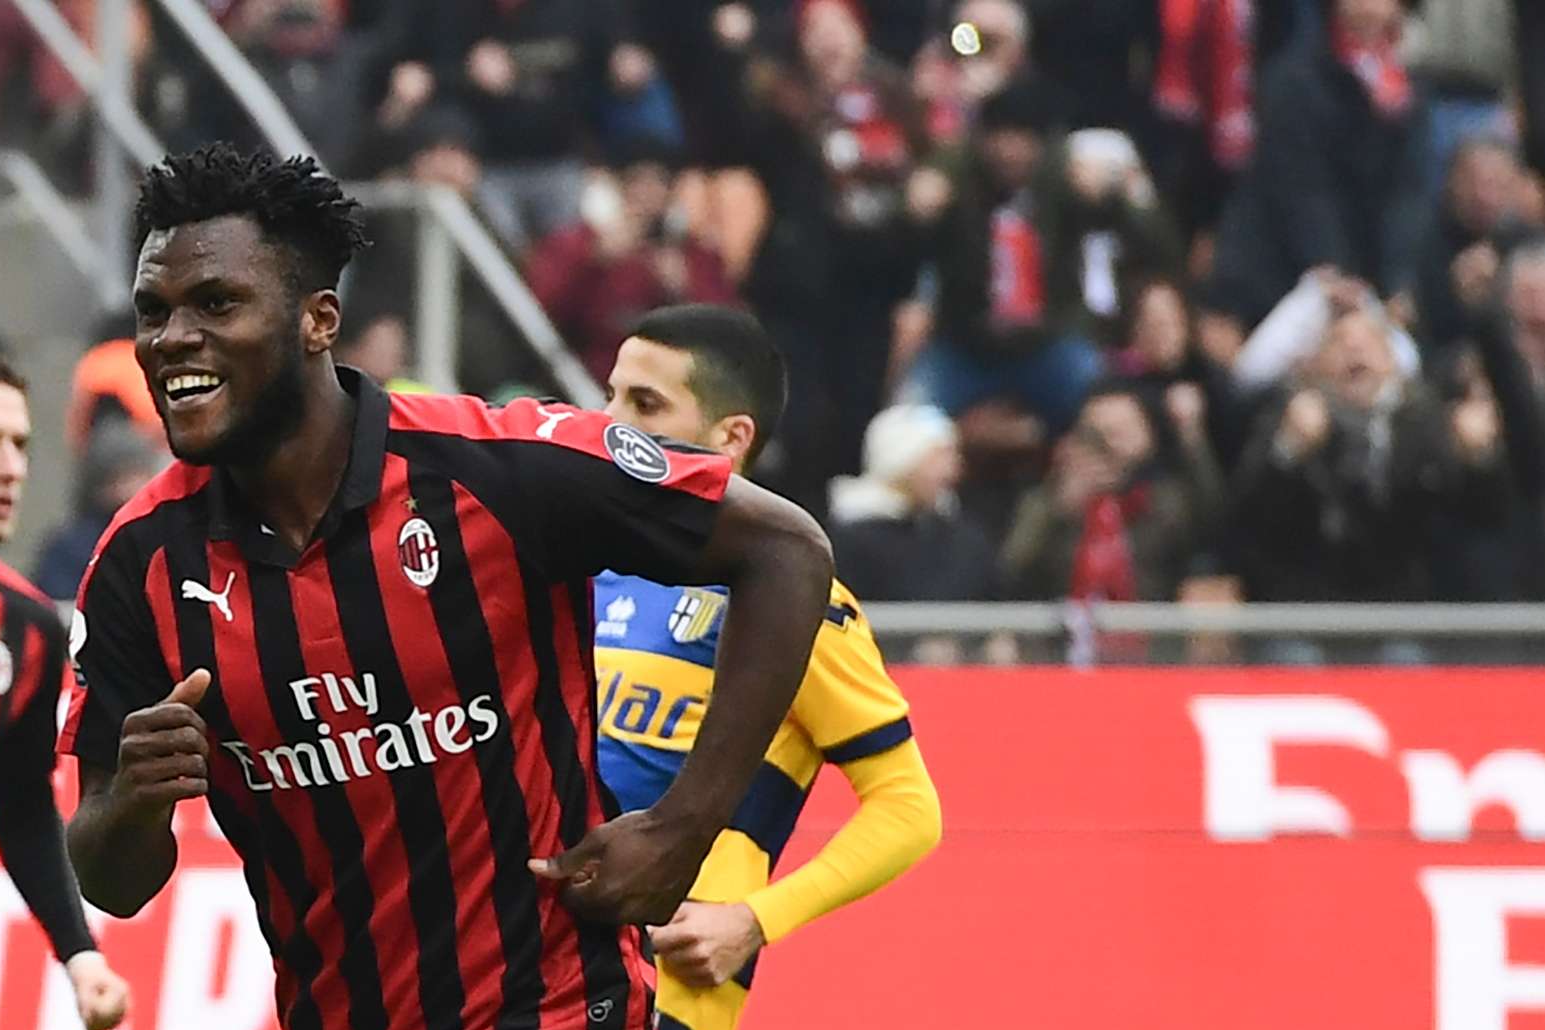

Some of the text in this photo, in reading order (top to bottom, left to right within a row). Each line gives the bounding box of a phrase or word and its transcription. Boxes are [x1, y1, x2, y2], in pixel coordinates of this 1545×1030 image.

[289, 672, 378, 721] Fly
[597, 671, 706, 739] lar
[222, 694, 498, 790] Emirates
